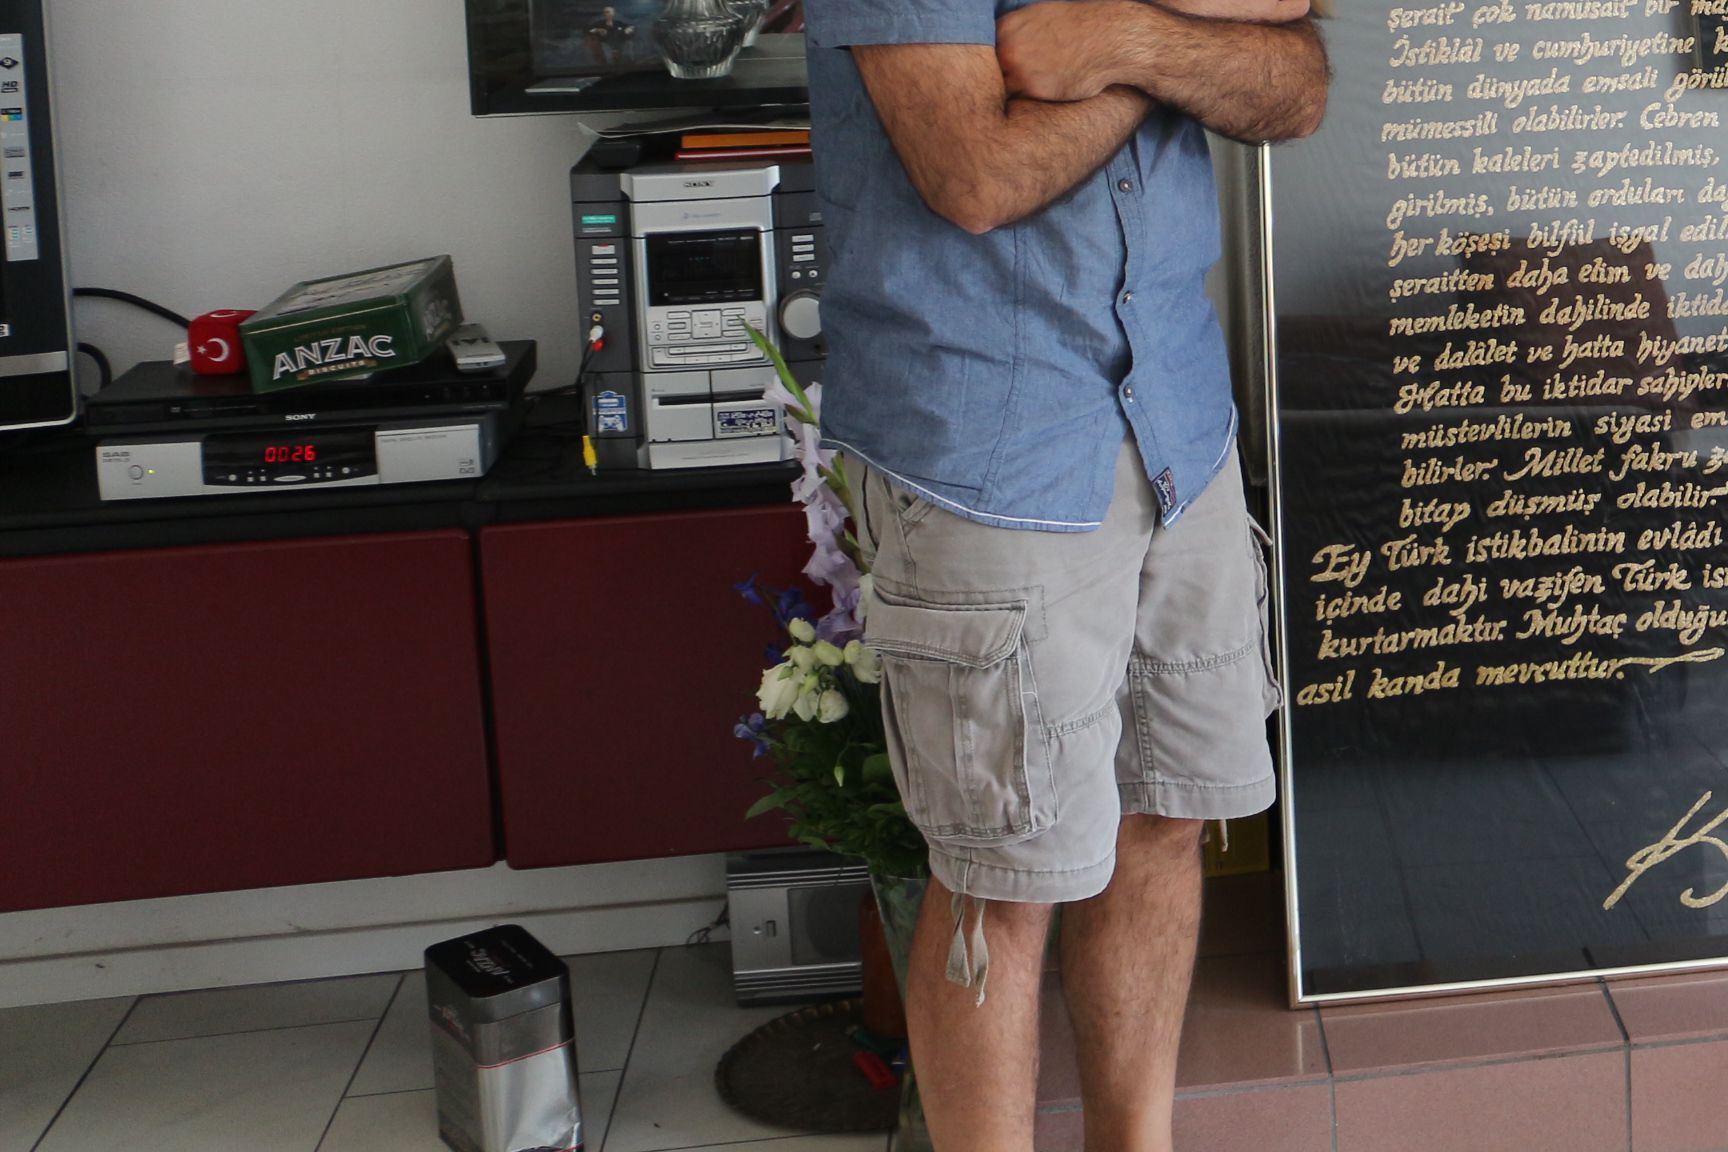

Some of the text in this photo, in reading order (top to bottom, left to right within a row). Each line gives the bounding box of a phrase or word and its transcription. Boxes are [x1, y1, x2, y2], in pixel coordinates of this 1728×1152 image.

[1388, 2, 1465, 33] şerait
[1494, 43, 1520, 61] ve
[1383, 78, 1452, 103] bütün
[1467, 68, 1570, 108] dünyada
[1583, 66, 1658, 93] emsali
[1640, 102, 1719, 129] Cebren
[1388, 153, 1460, 179] bütün
[1472, 146, 1559, 173] kaleleri
[1507, 186, 1577, 211] bütün
[1388, 231, 1434, 267] her
[1609, 216, 1672, 254] işgal
[1389, 268, 1495, 303] şeraitten
[1506, 258, 1569, 296] daha
[1645, 263, 1671, 280] ve
[1539, 292, 1650, 332] dahilinde
[272, 335, 396, 380] ANZAC
[1393, 355, 1422, 375] ve
[1557, 334, 1625, 370] hatta
[1391, 380, 1486, 416] Hatta
[1500, 374, 1532, 403] bu
[1542, 369, 1633, 400] iktidar
[285, 413, 317, 421] SONY
[1593, 406, 1672, 445] siyasi
[1502, 446, 1605, 482] Millet
[1608, 441, 1698, 482] fakru
[1399, 487, 1602, 533] bitap düşmüş
[1309, 543, 1372, 589] Ey
[1380, 533, 1453, 572] Türk
[1315, 558, 1692, 626] içinde dahi vazifen Türk
[1515, 604, 1628, 646] Muhtaç
[1296, 669, 1356, 706] asil
[1366, 660, 1462, 699] kanda
